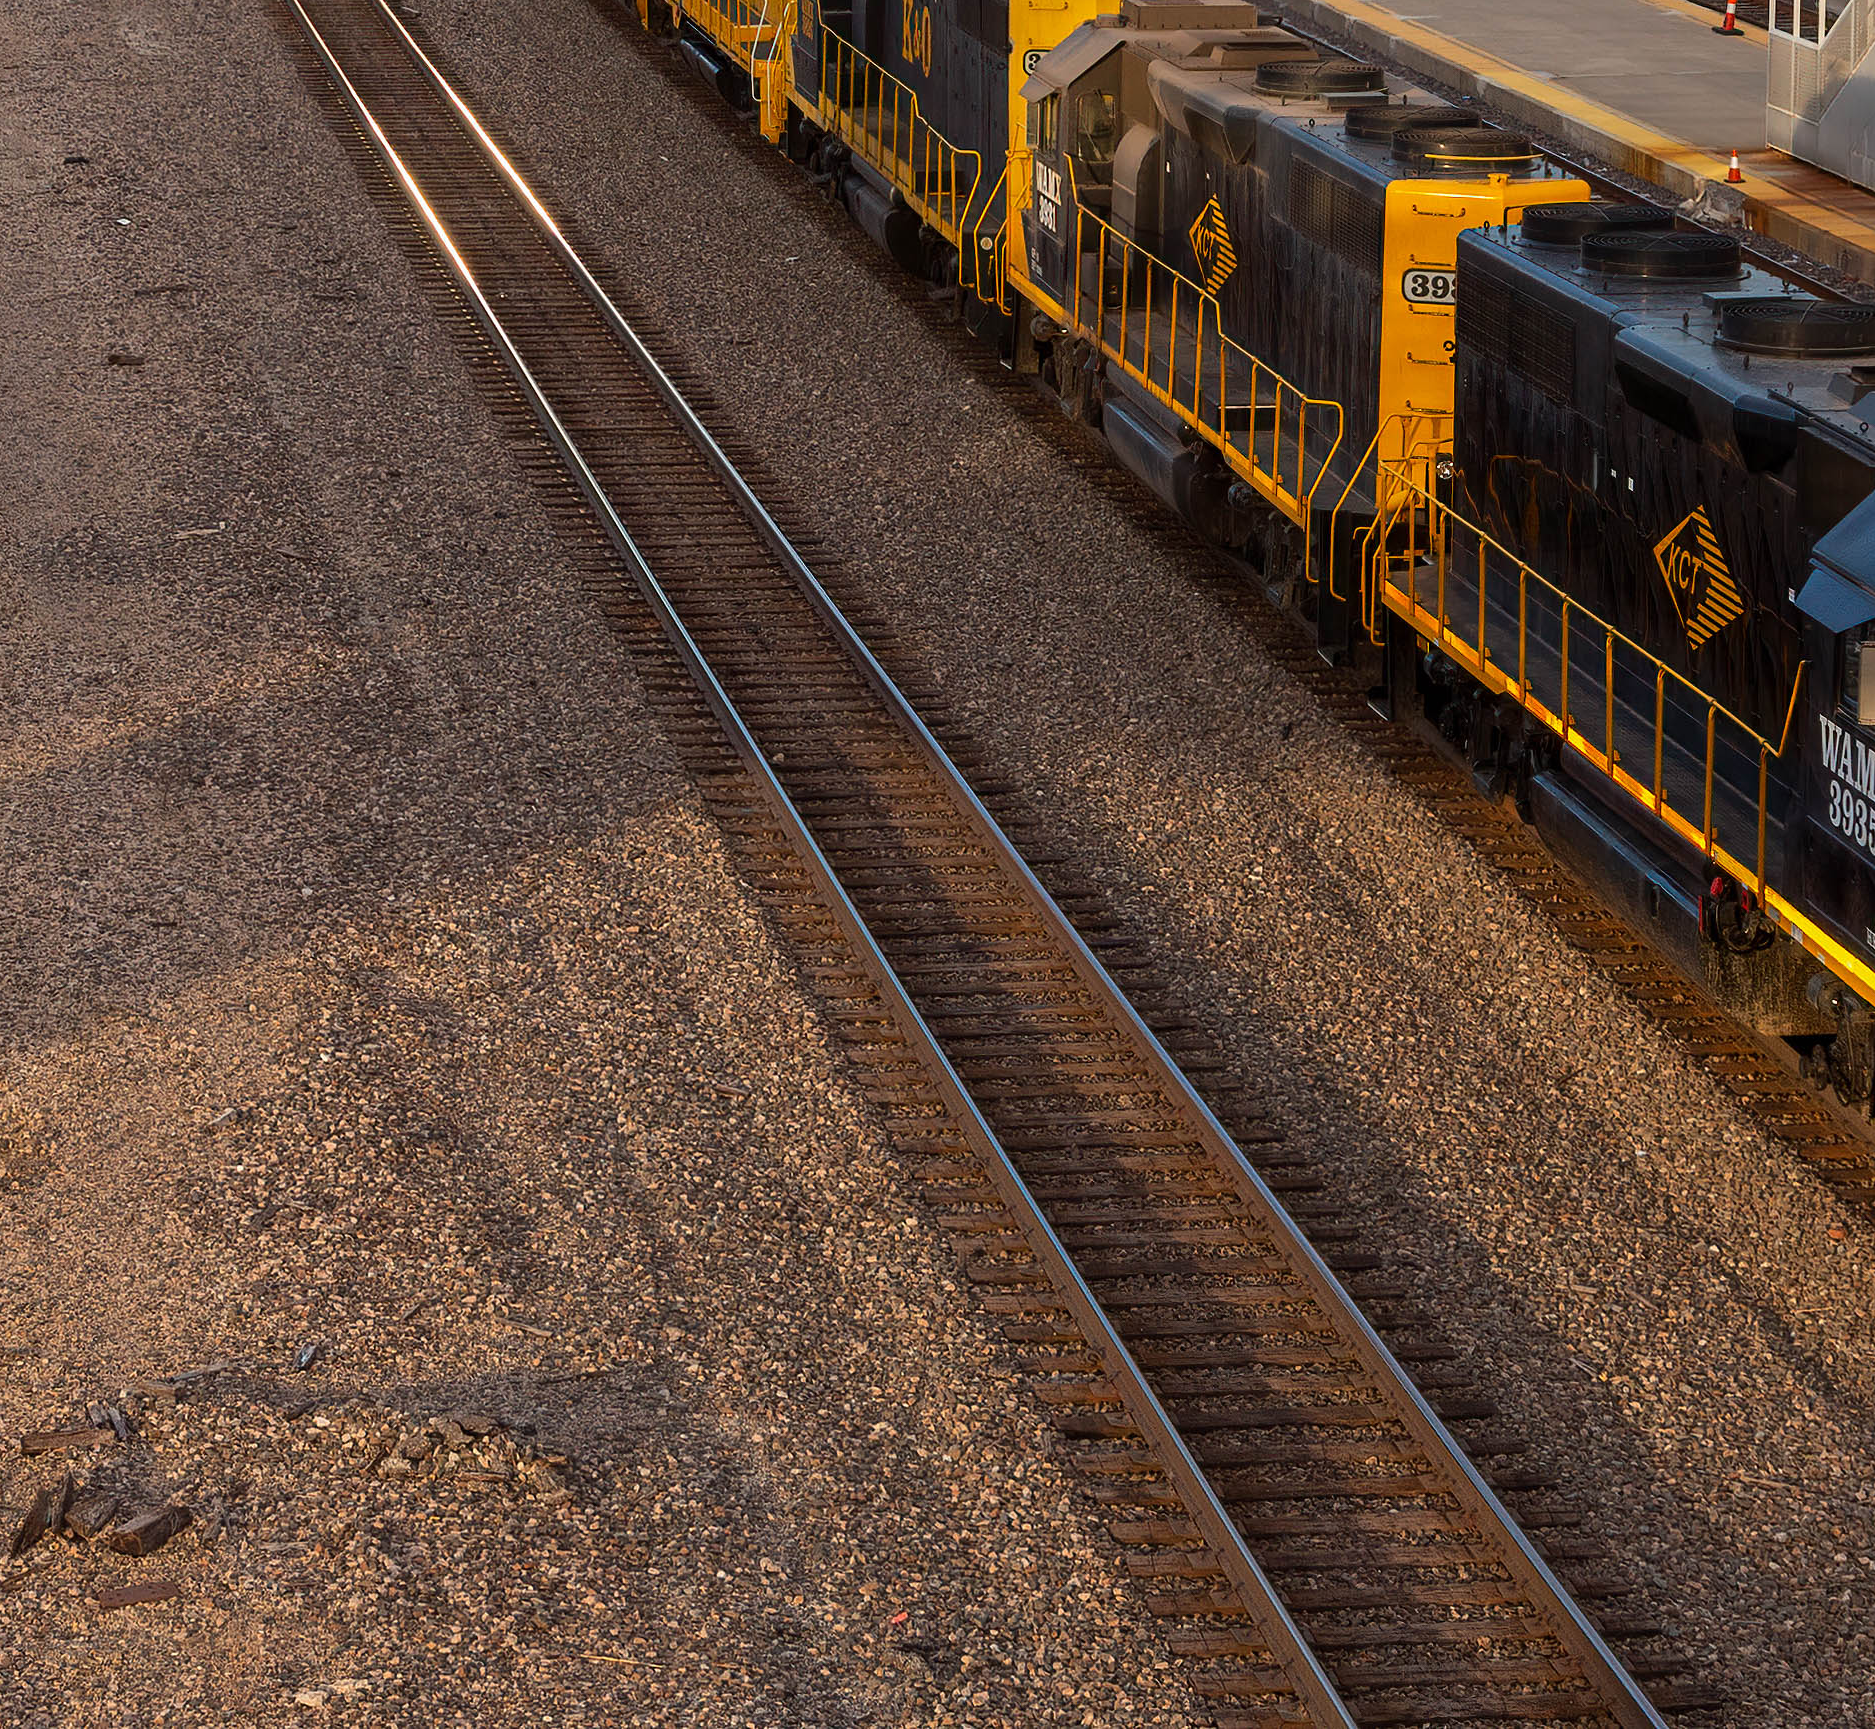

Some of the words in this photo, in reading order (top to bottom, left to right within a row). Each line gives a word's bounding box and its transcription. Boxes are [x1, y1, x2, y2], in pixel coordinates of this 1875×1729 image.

[1195, 225, 1216, 260] KCT
[1411, 274, 1457, 299] 39
[1667, 542, 1702, 595] KCT
